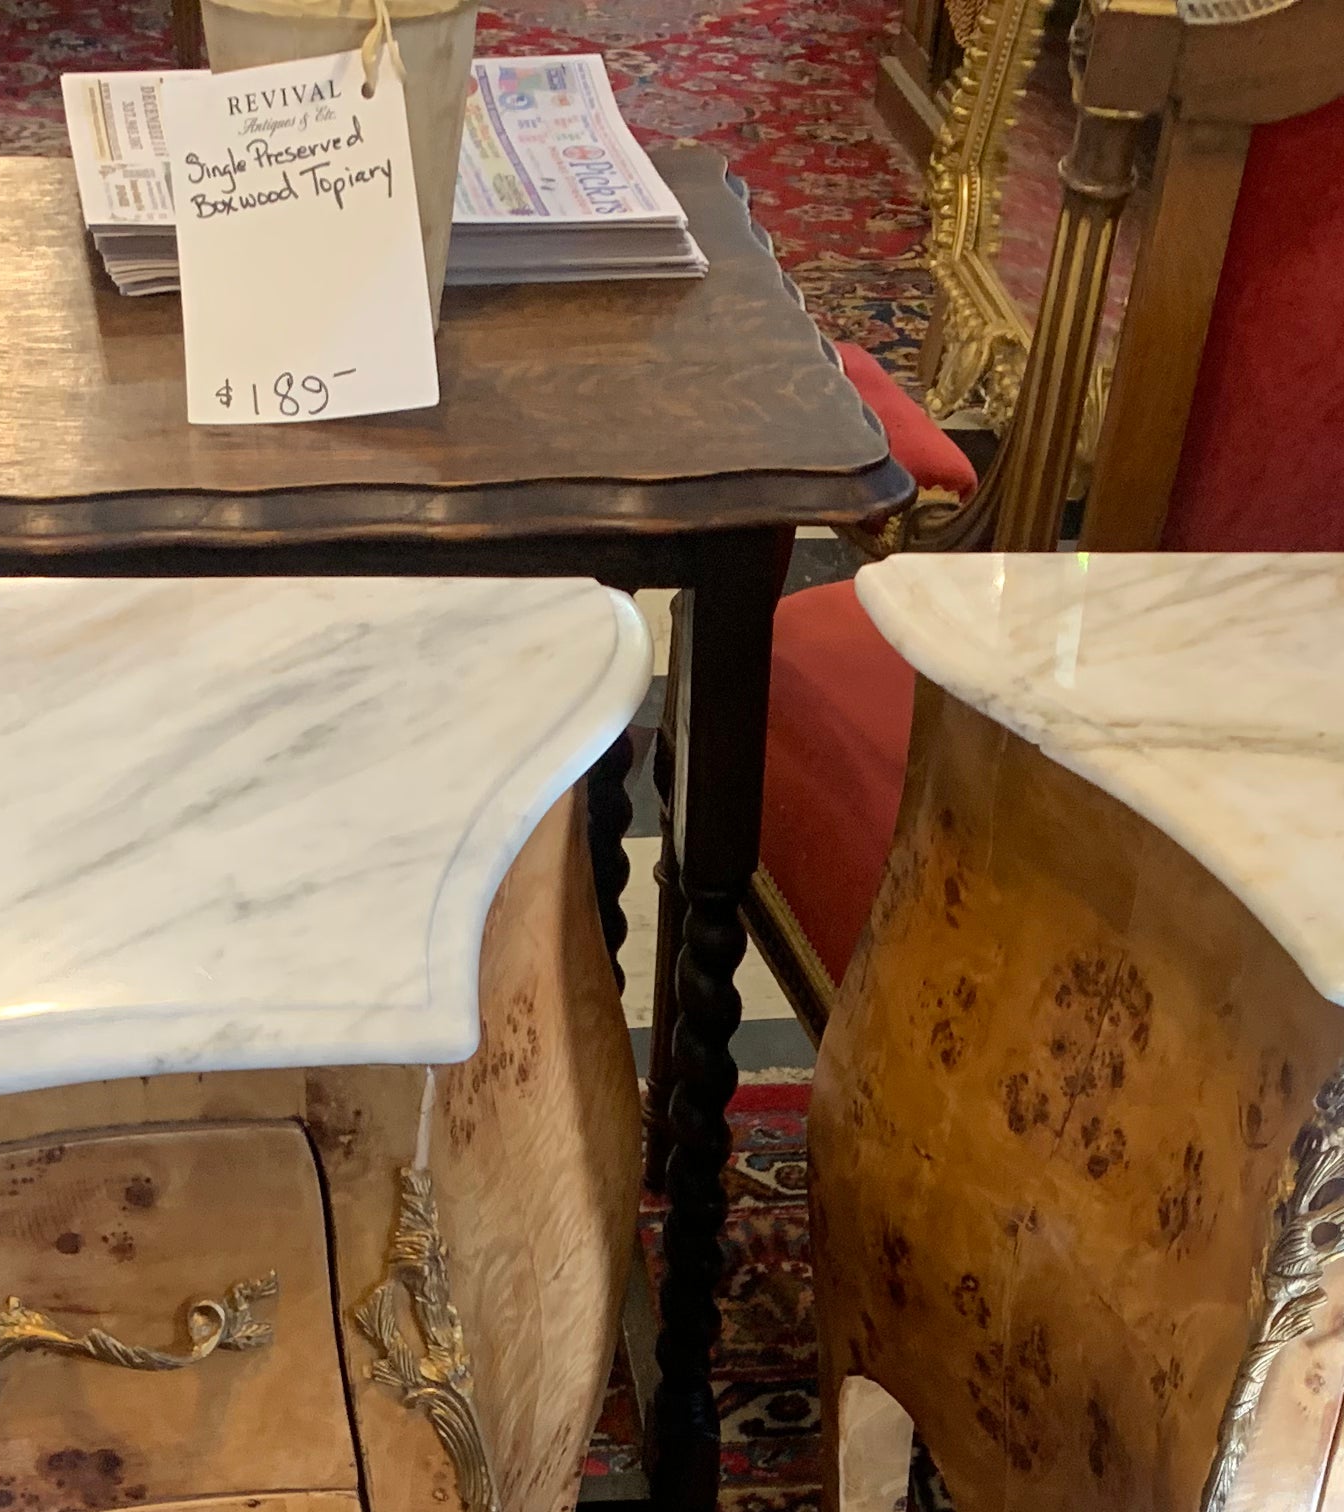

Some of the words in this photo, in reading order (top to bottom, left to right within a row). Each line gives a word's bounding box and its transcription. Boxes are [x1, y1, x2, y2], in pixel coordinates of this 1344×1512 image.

[227, 79, 342, 116] REVIVAL
[238, 114, 296, 138] Antiques
[299, 112, 309, 132] &
[315, 105, 337, 123] Etc.
[185, 147, 247, 194] Single
[246, 114, 364, 168] Preserved
[190, 170, 299, 219] Boxwood
[299, 157, 394, 210] Topiary
